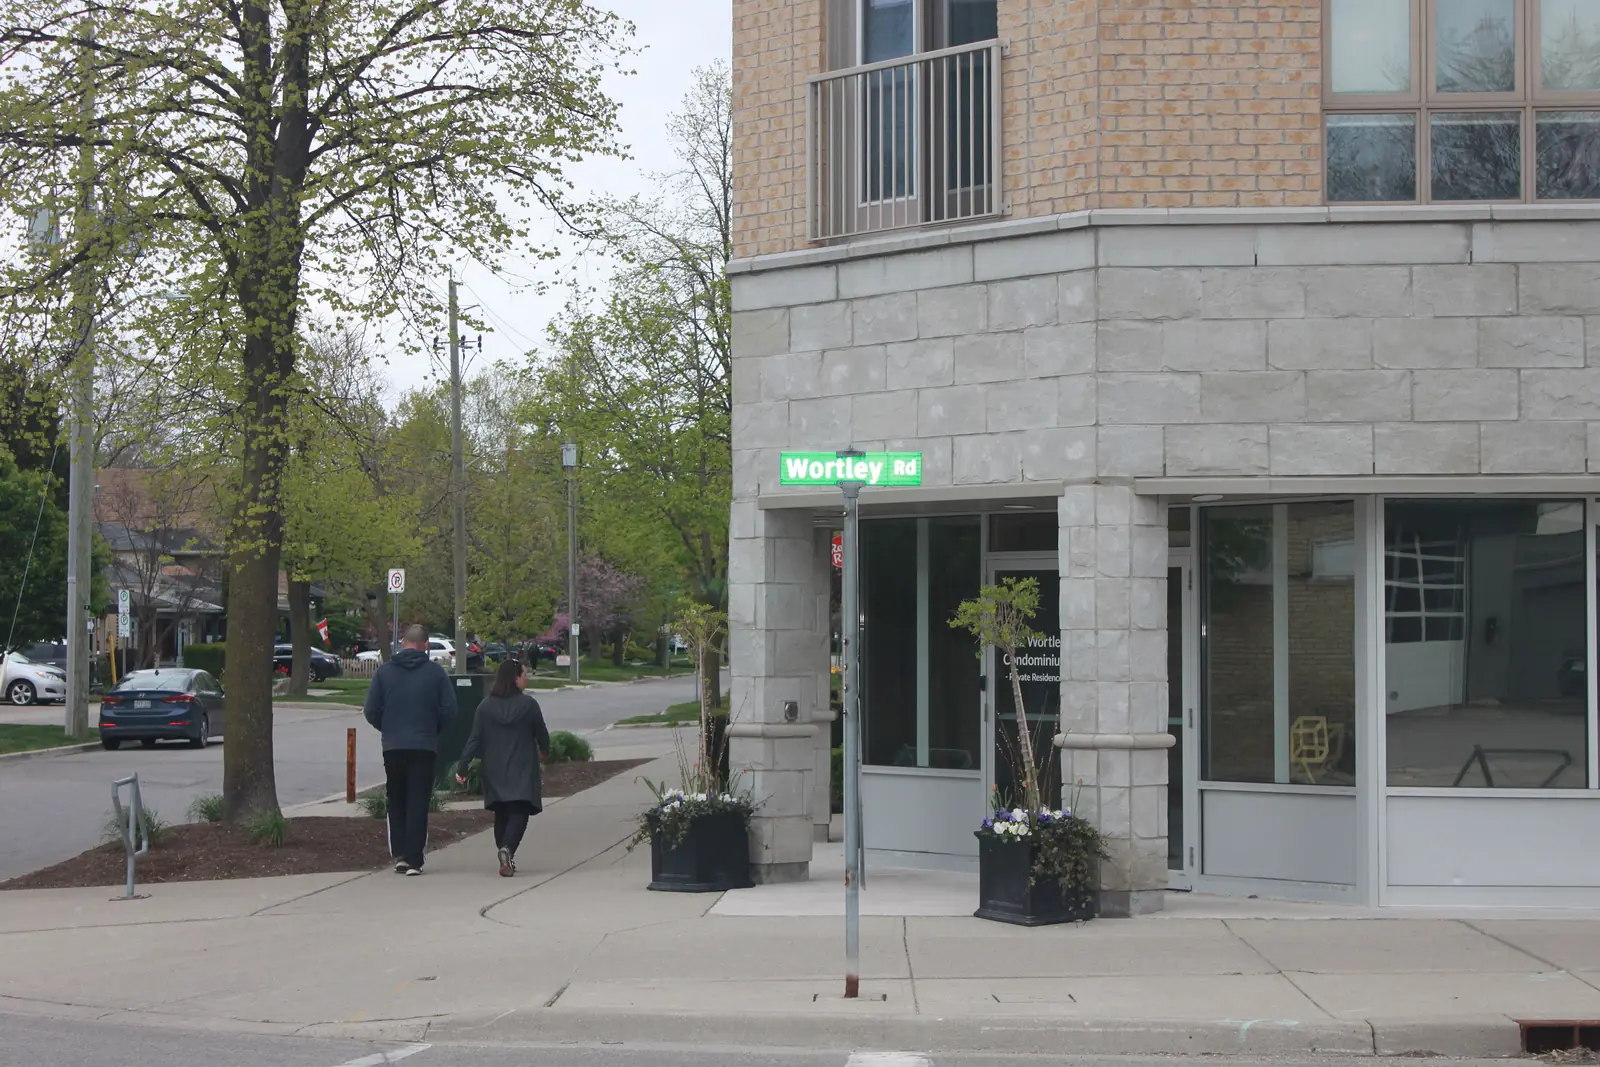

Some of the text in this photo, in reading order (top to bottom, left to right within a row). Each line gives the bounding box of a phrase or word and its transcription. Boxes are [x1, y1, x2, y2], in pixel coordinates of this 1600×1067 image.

[785, 457, 917, 484] Wortley Rd
[1027, 635, 1060, 648] Wortle
[1003, 653, 1060, 666] Cndominiu
[1009, 673, 1031, 682] Pvate
